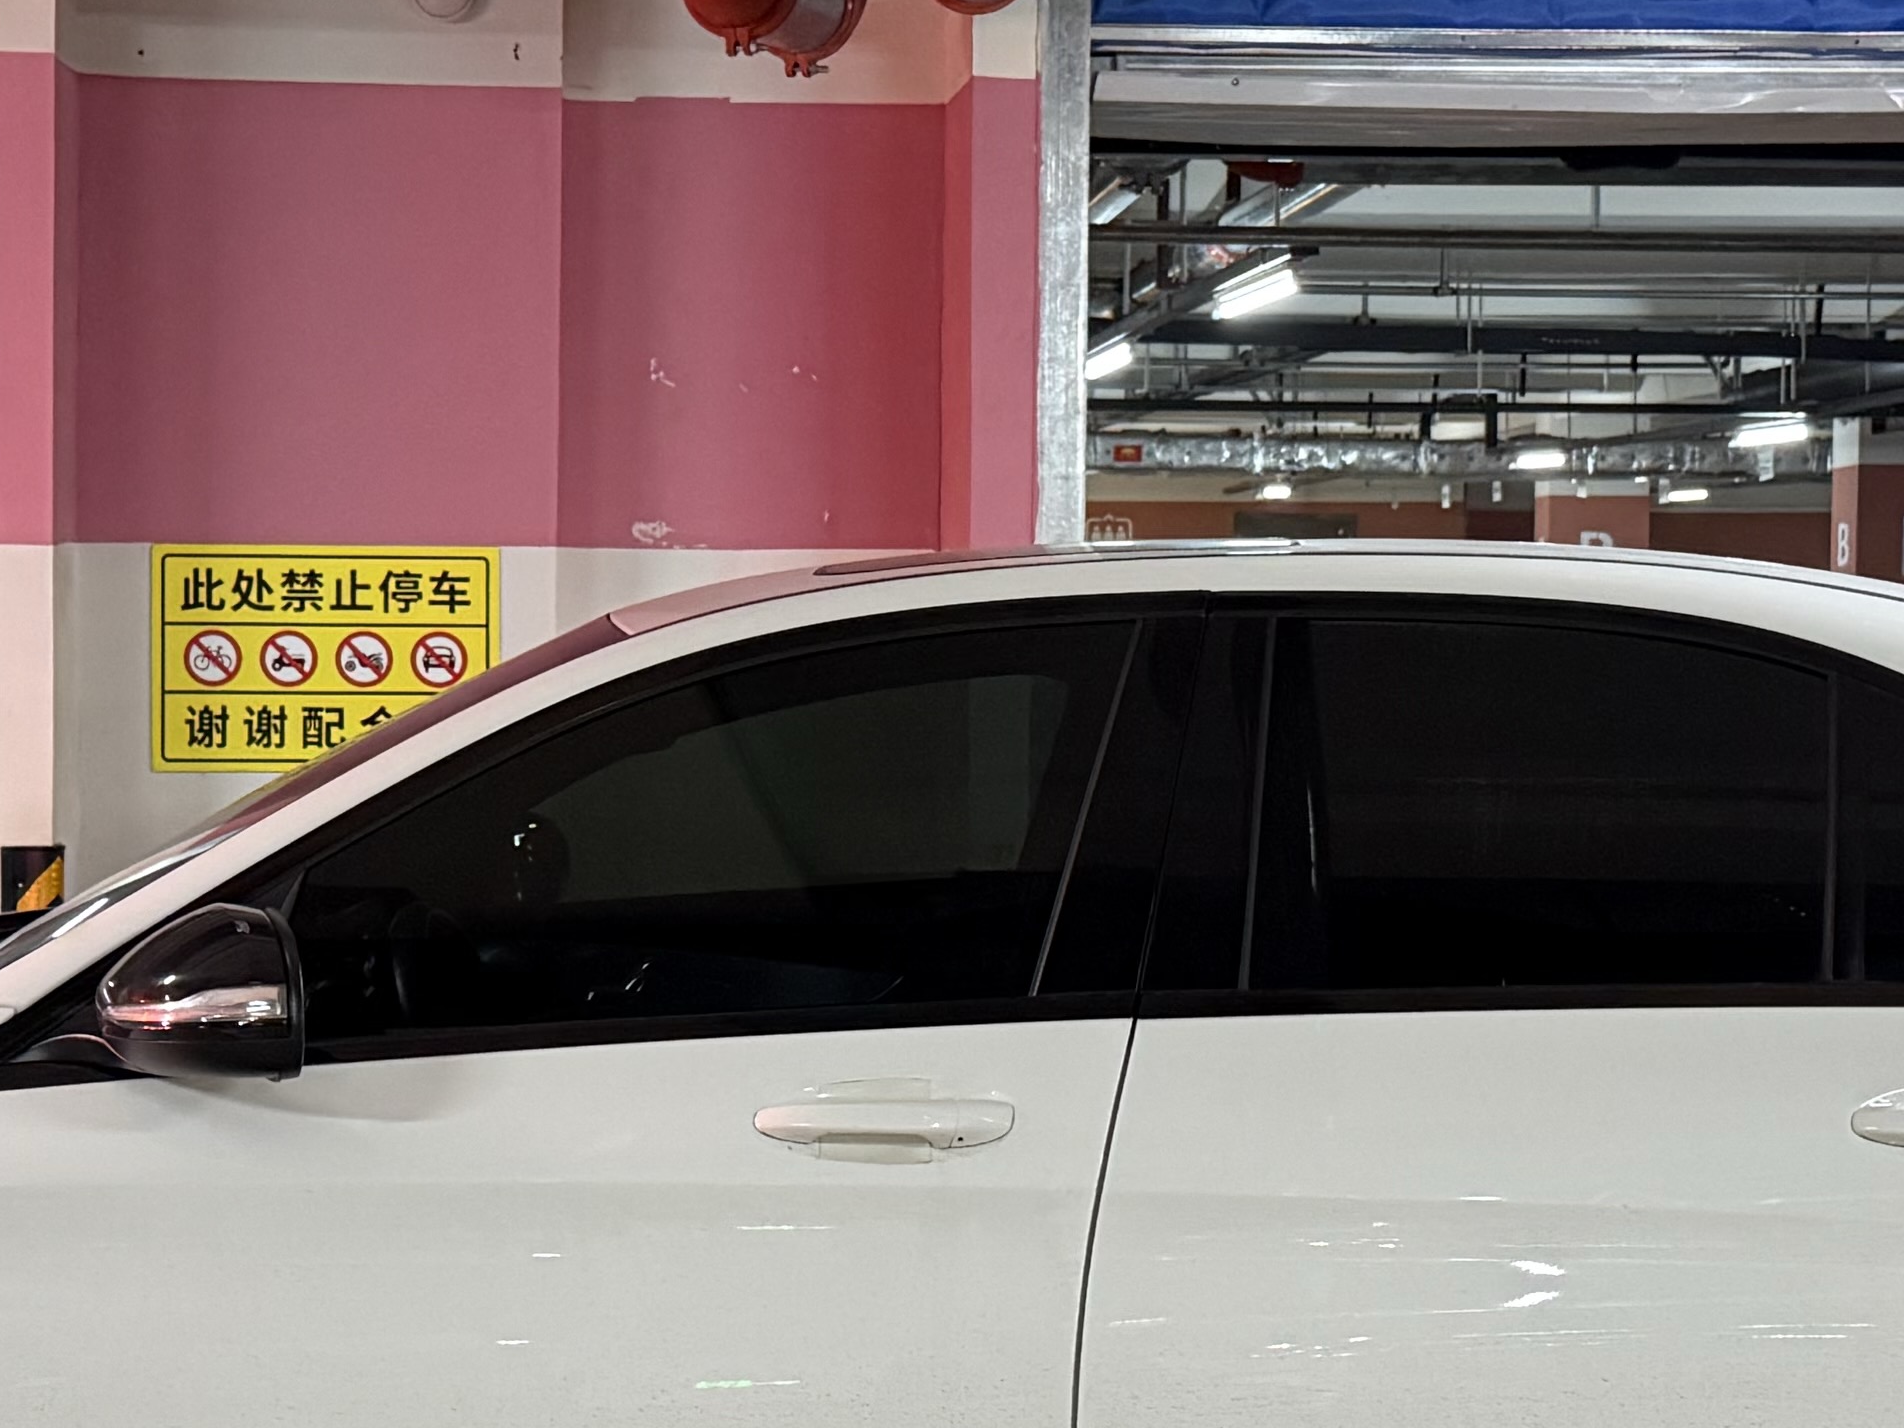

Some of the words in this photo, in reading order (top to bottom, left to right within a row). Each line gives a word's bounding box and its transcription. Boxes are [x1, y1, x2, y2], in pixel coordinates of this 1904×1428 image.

[1837, 522, 1849, 567] B
[180, 567, 472, 614] 此处禁止停车
